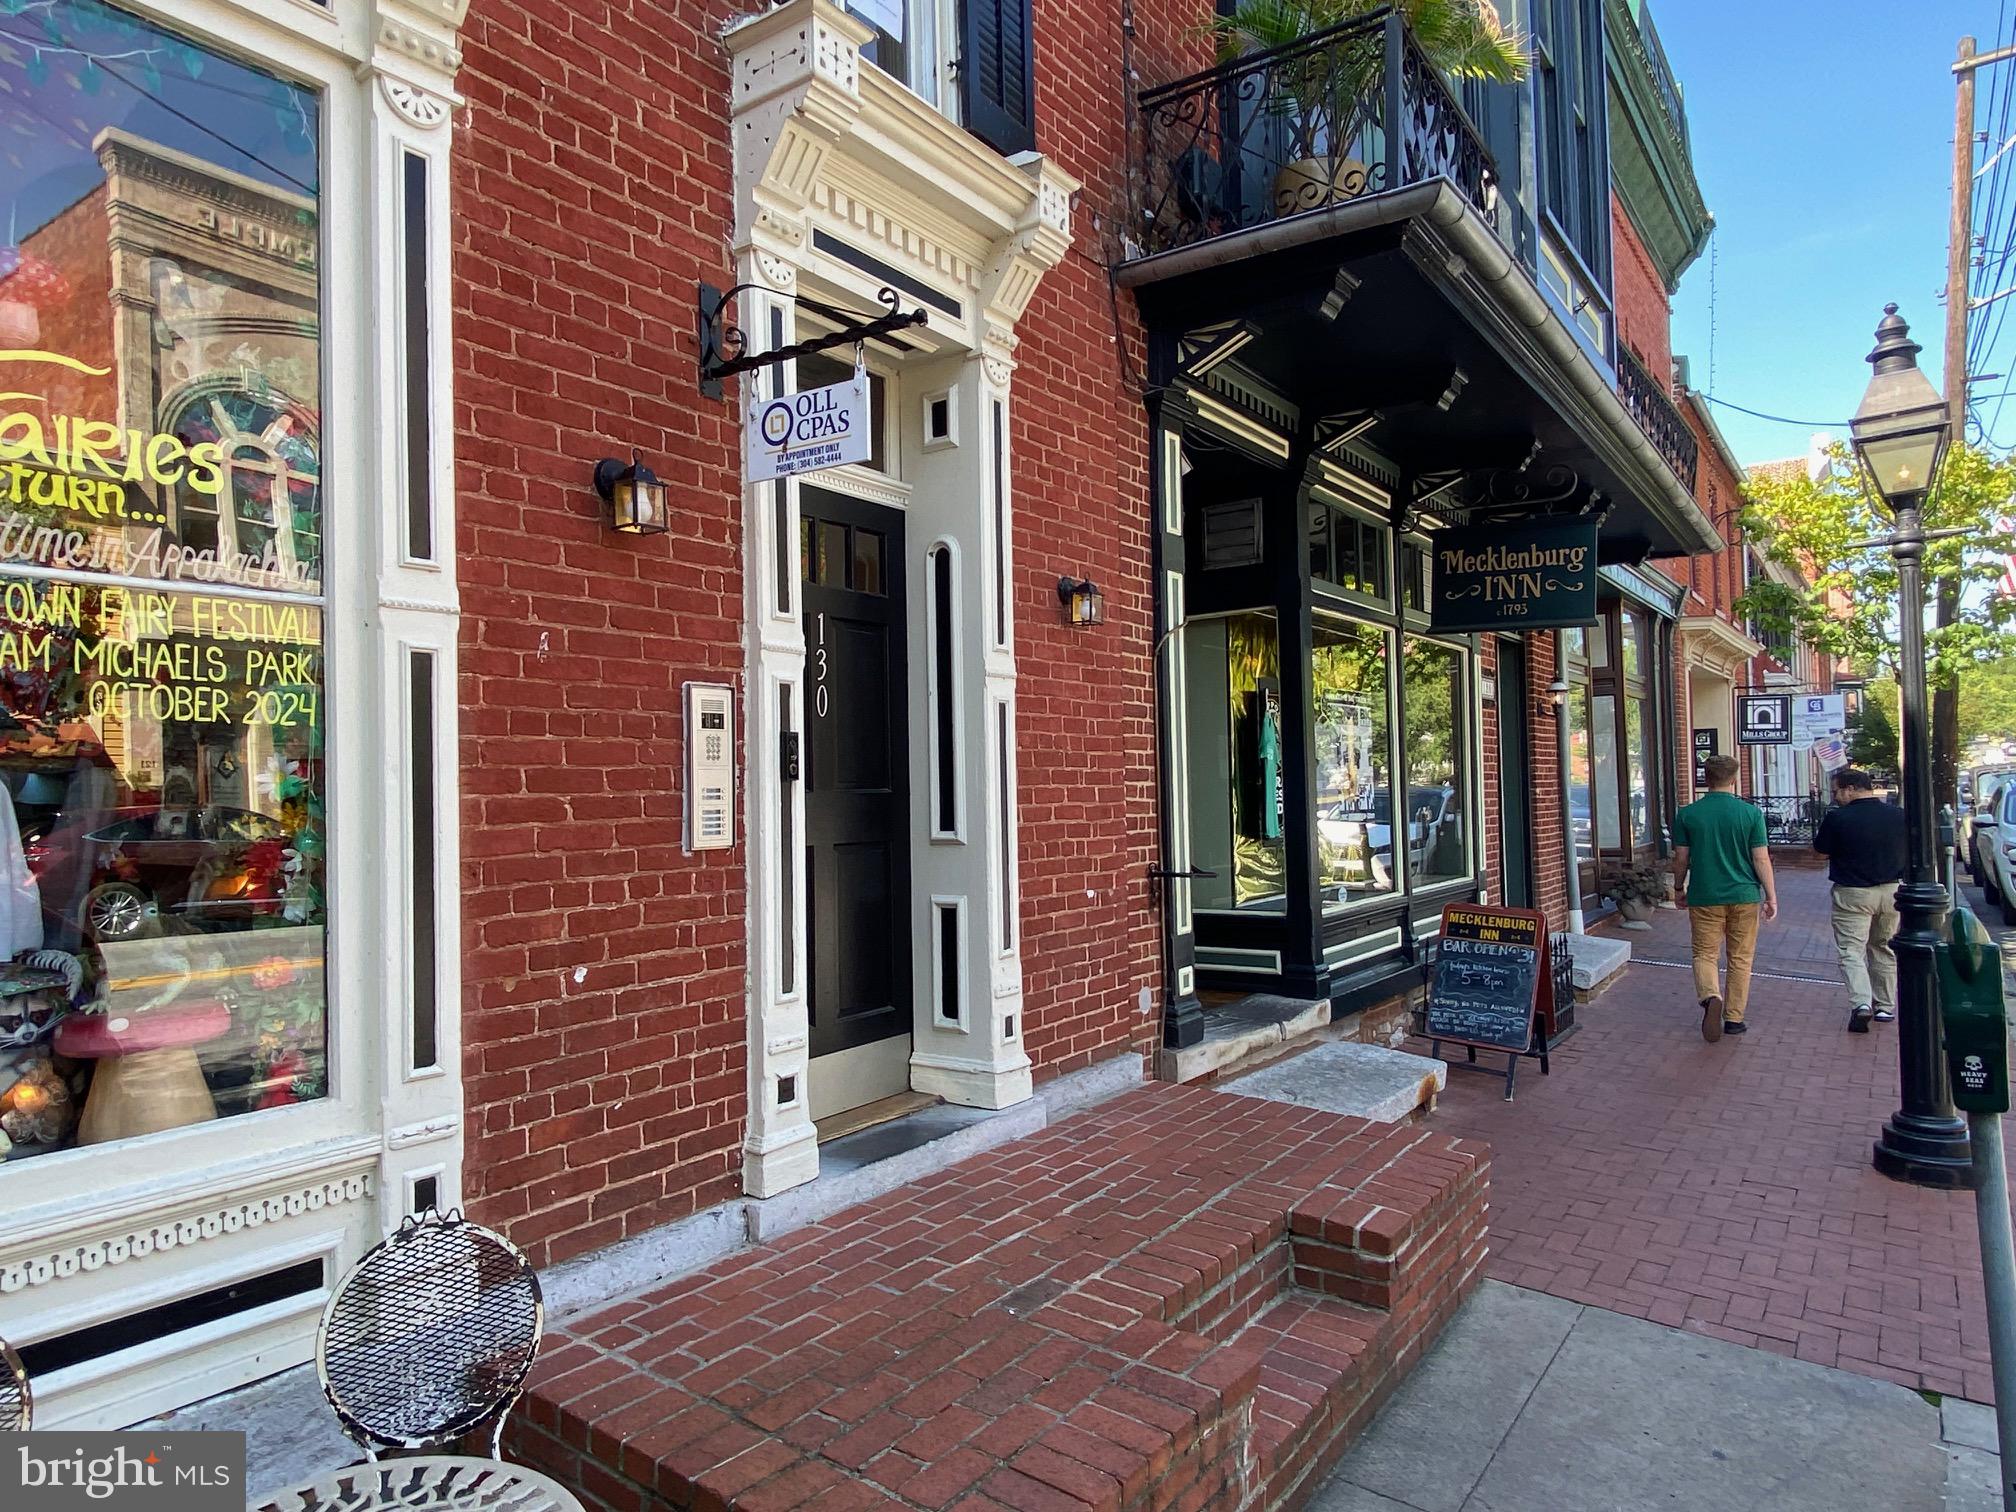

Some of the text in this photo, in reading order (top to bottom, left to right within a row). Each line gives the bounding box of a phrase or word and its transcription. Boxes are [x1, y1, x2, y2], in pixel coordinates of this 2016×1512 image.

[796, 389, 838, 417] OLL
[796, 409, 850, 441] CPAS
[785, 445, 825, 462] APPOINTMENT
[825, 442, 840, 453] ONLY
[775, 462, 797, 474] PHONE:
[1440, 543, 1588, 573] Mecklenburg
[1484, 572, 1542, 601] INN
[0, 579, 312, 646] OWN FAIRY FESTIVAL
[1503, 603, 1528, 616] 1793
[74, 638, 228, 683] MICHAELS
[245, 650, 317, 687] PARK
[89, 681, 316, 727] OCTOBER 2024
[1742, 730, 1763, 738] MILLS
[1763, 730, 1788, 738] GROUP
[1450, 912, 1535, 931] MECKLENBURG
[1479, 928, 1500, 941] INN
[1443, 939, 1471, 954] BAR
[1474, 943, 1508, 956] OPEN
